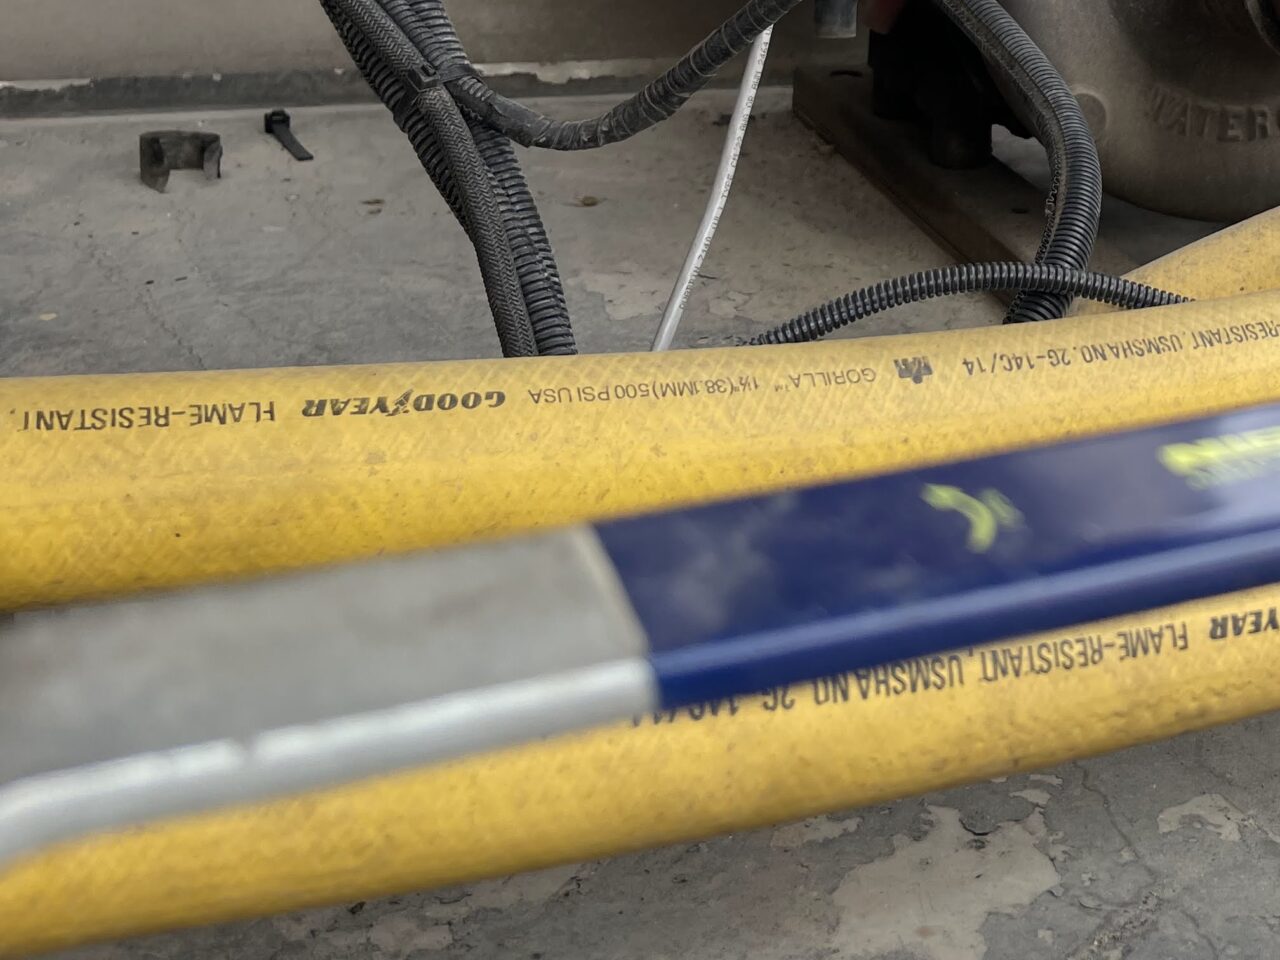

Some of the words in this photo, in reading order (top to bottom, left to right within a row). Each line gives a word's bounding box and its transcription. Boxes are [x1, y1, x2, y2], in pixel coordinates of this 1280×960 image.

[962, 348, 1071, 377] 2G-14C/14
[302, 389, 506, 418] GOODYEAR
[528, 387, 570, 404] USA
